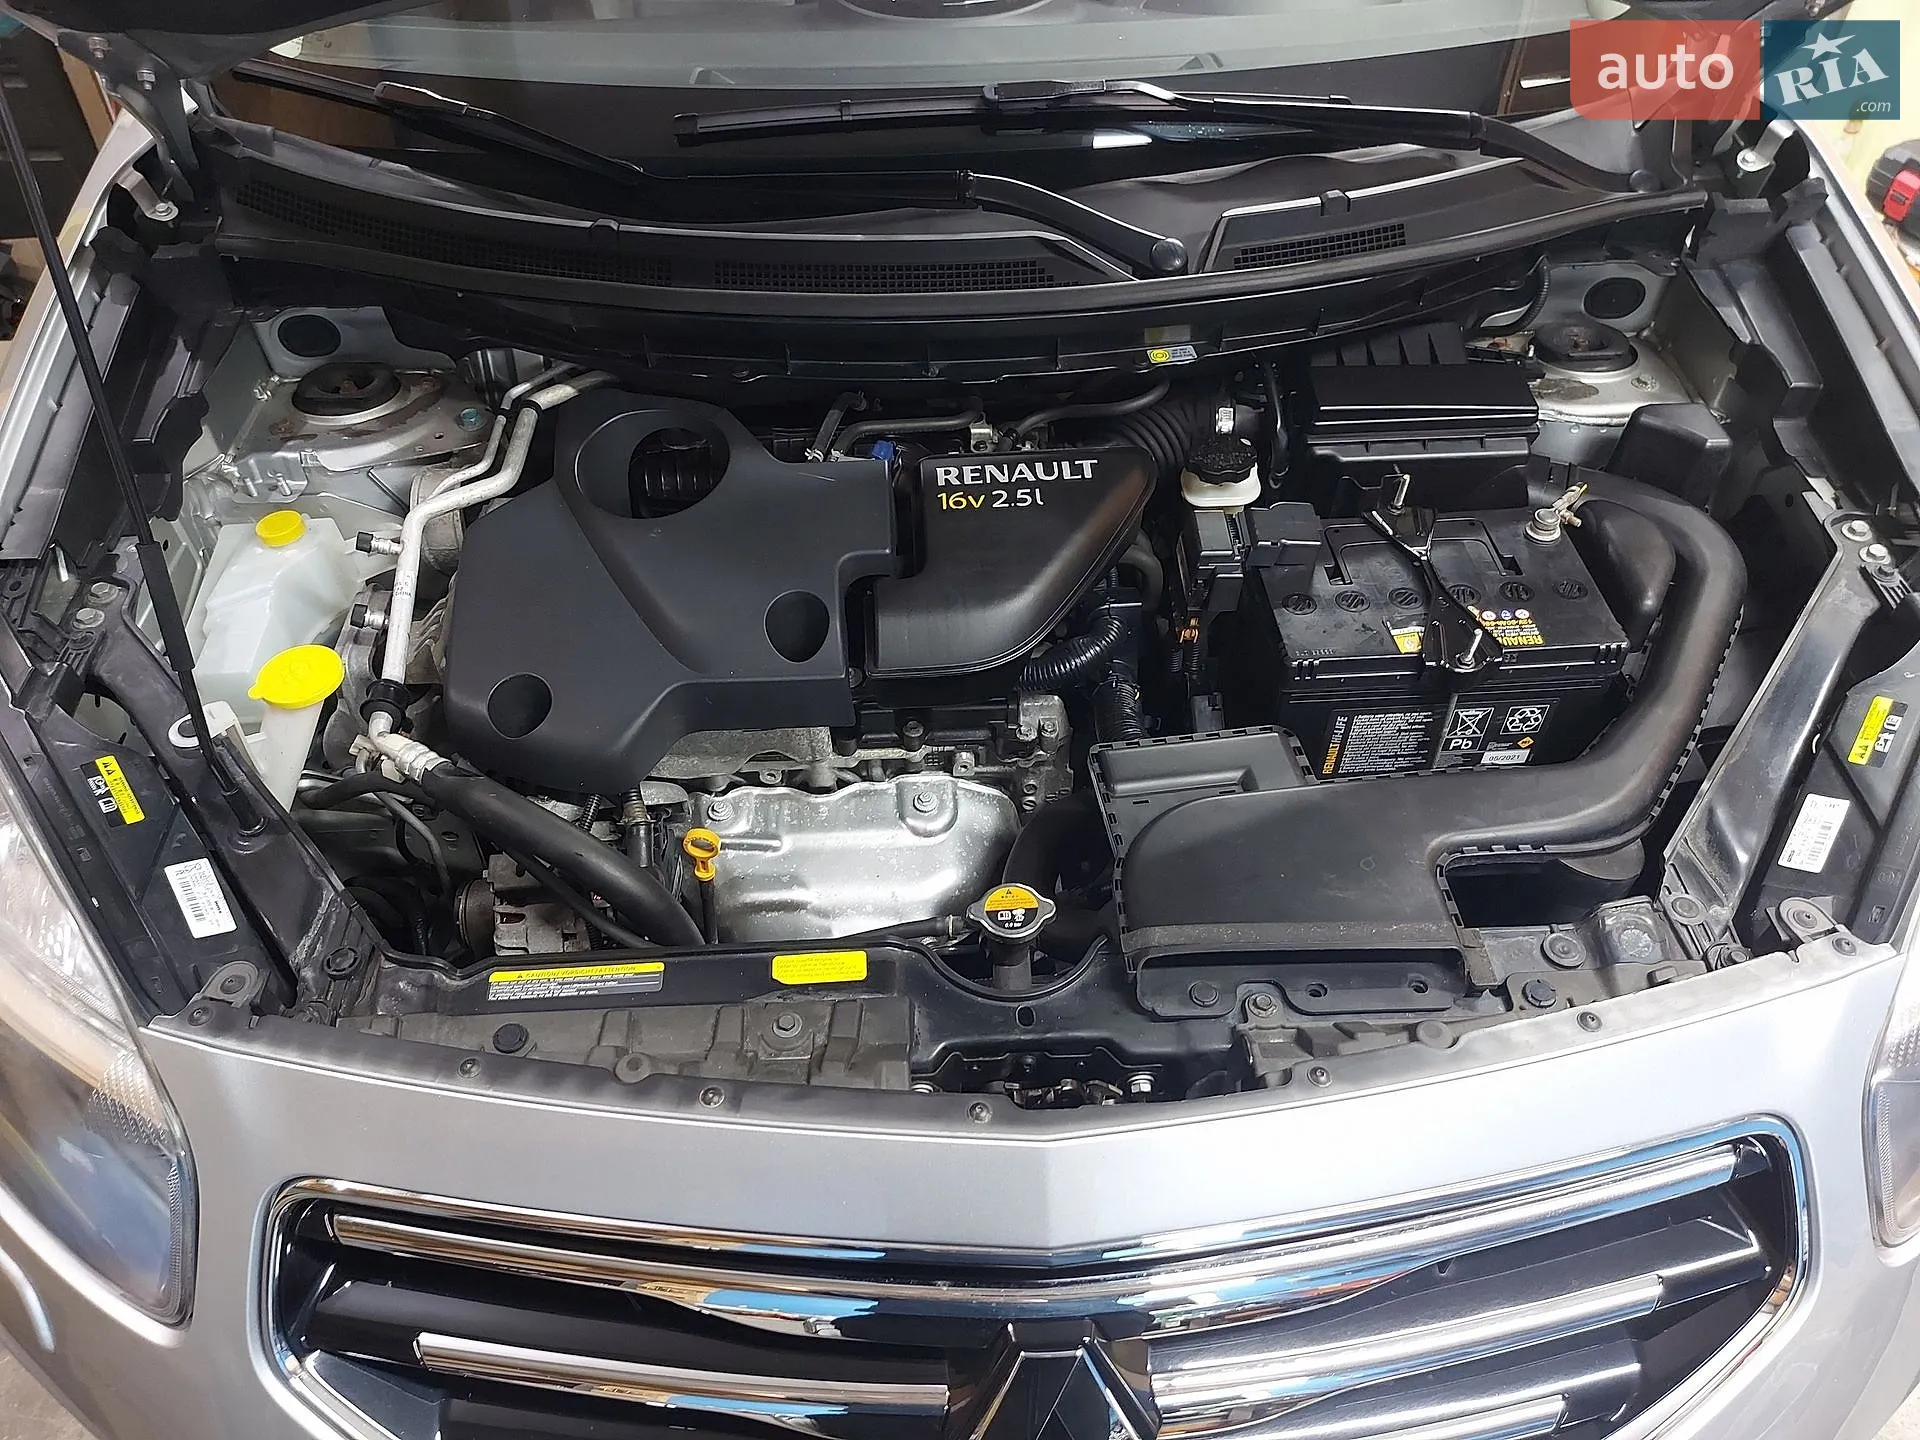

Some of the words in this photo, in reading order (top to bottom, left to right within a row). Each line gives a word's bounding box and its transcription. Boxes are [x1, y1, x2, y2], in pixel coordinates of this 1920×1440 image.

[936, 459, 1099, 487] RENAULT
[937, 491, 985, 510] 16v
[991, 488, 1044, 509] 2.5l
[1496, 634, 1545, 647] RENAUL
[1449, 738, 1472, 751] Pb
[1322, 741, 1341, 775] RENAULT
